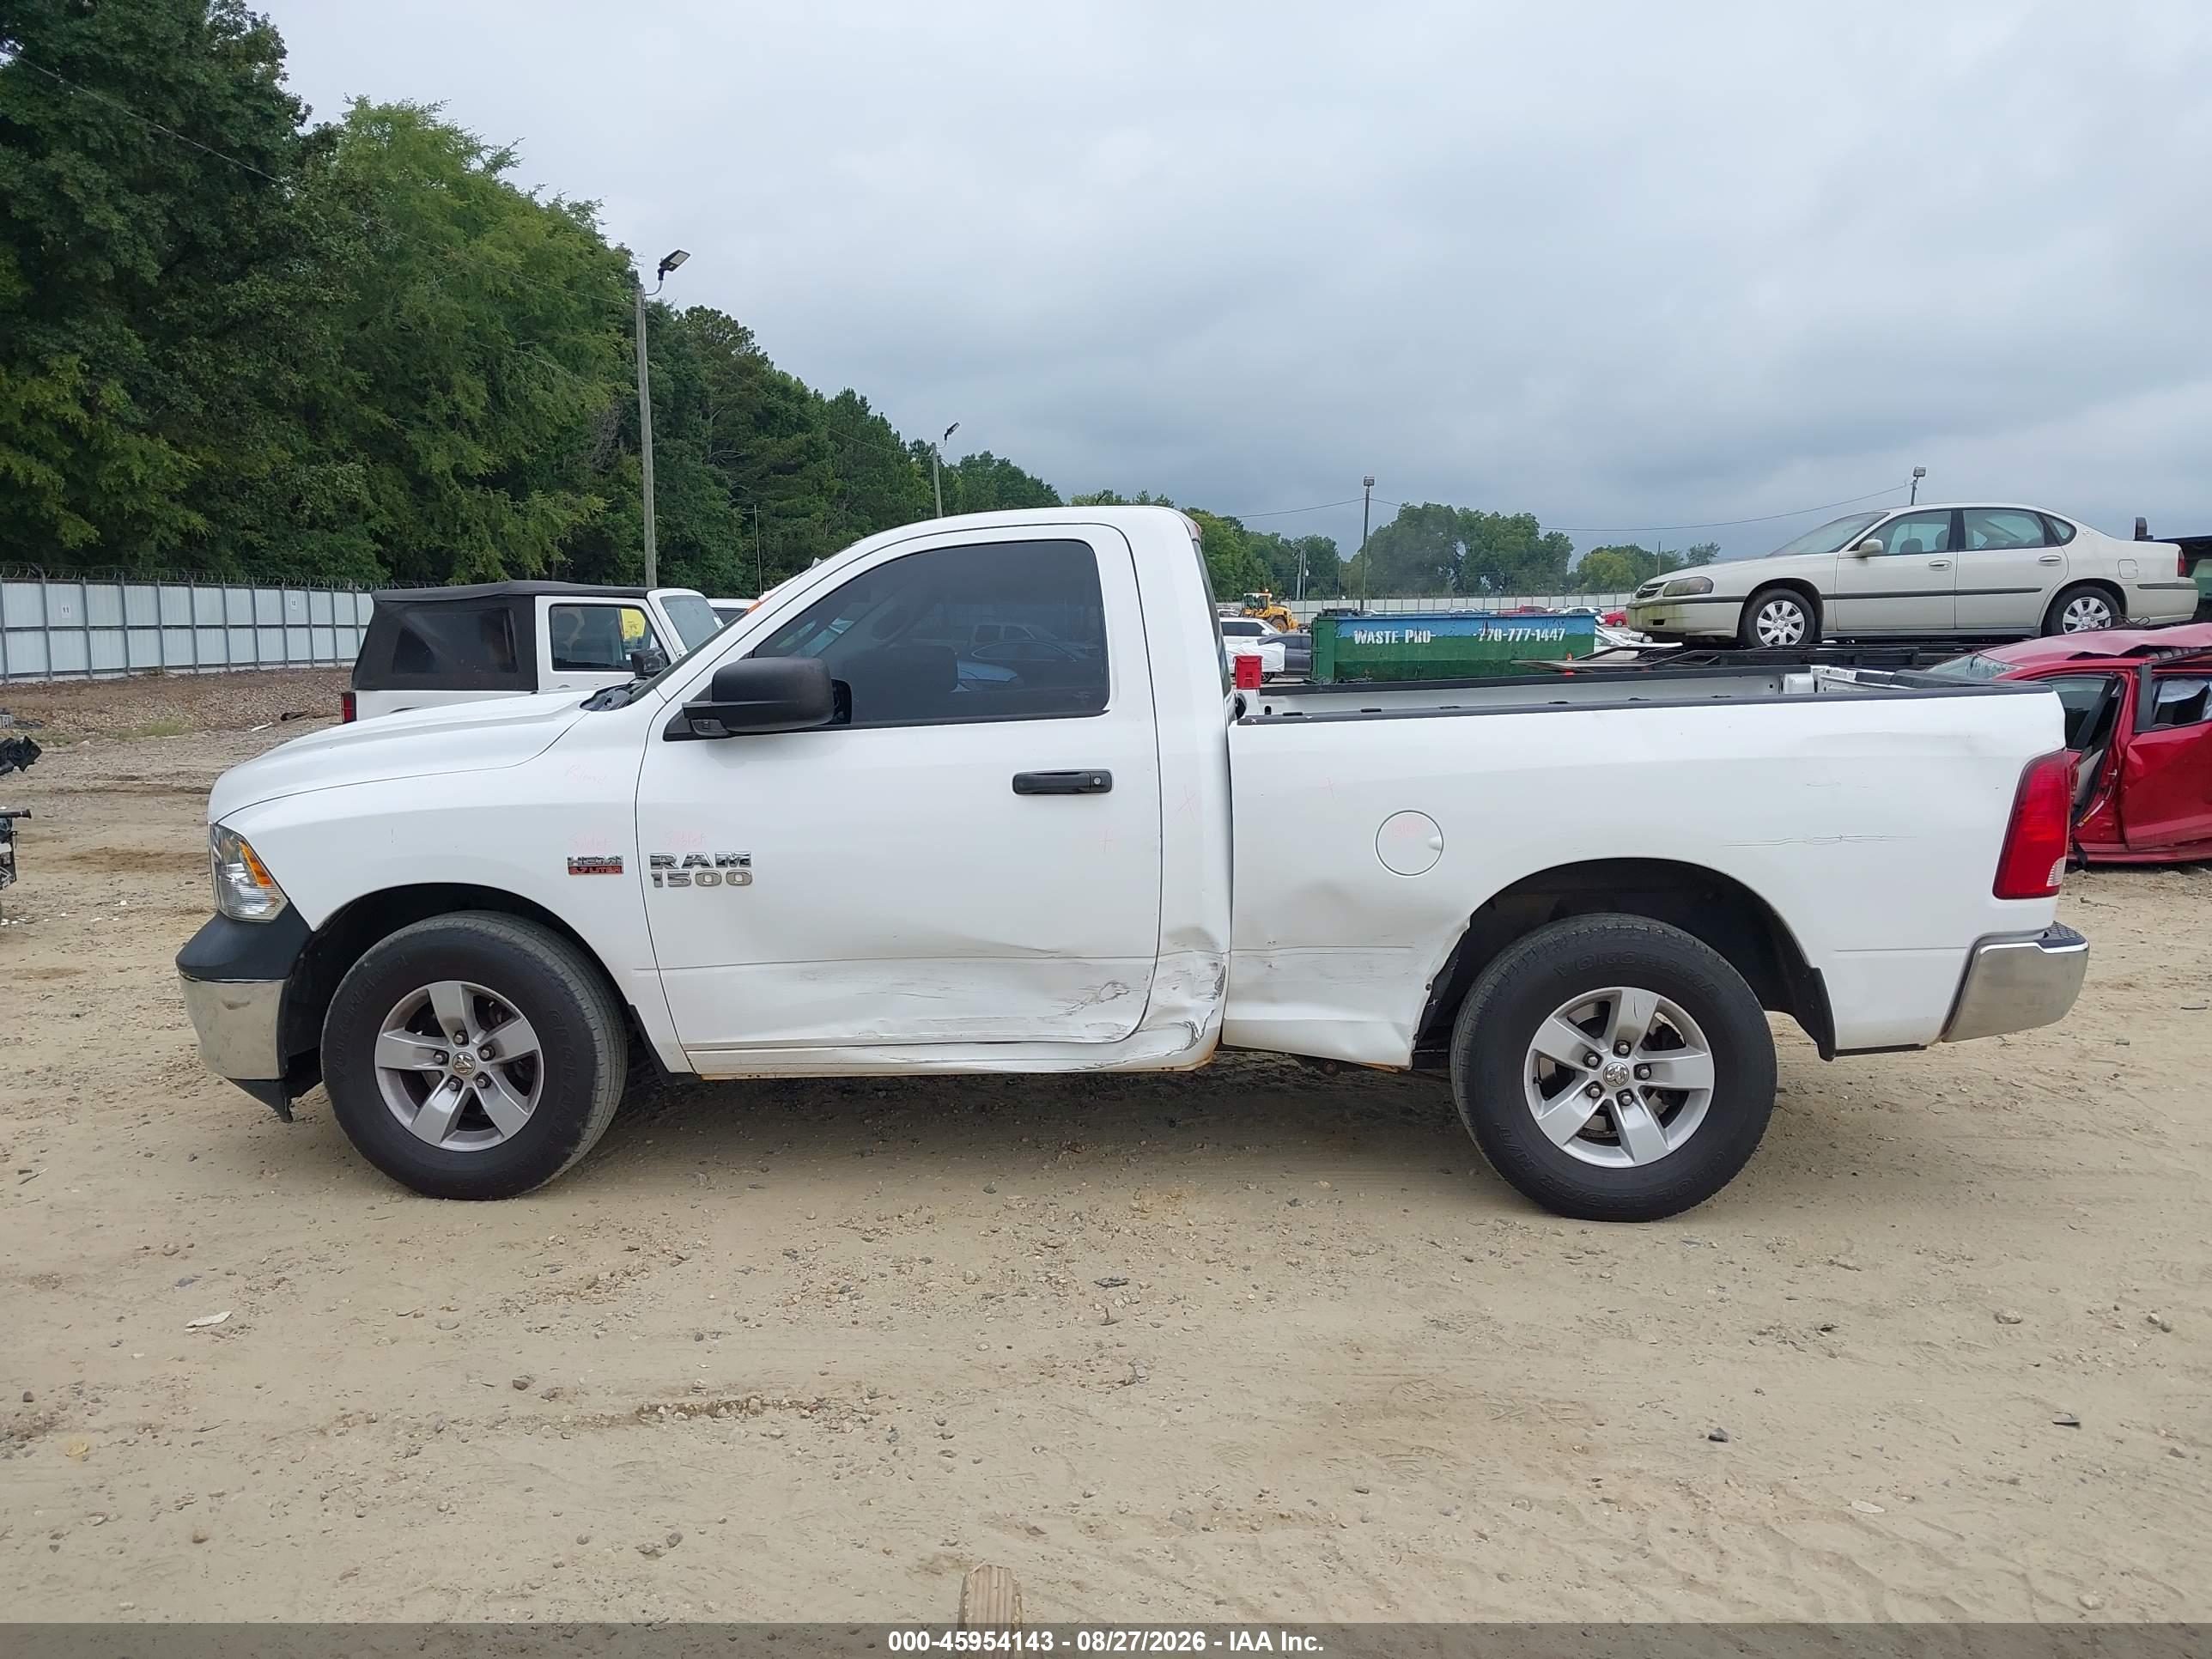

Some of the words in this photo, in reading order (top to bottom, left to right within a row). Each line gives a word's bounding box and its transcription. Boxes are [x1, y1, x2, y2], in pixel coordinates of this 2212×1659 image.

[1354, 629, 1399, 644] WASTE
[567, 856, 623, 866] HEMI
[649, 852, 751, 869] RAM
[651, 870, 753, 888] 1500
[1556, 951, 1720, 997] YOKOHAMA
